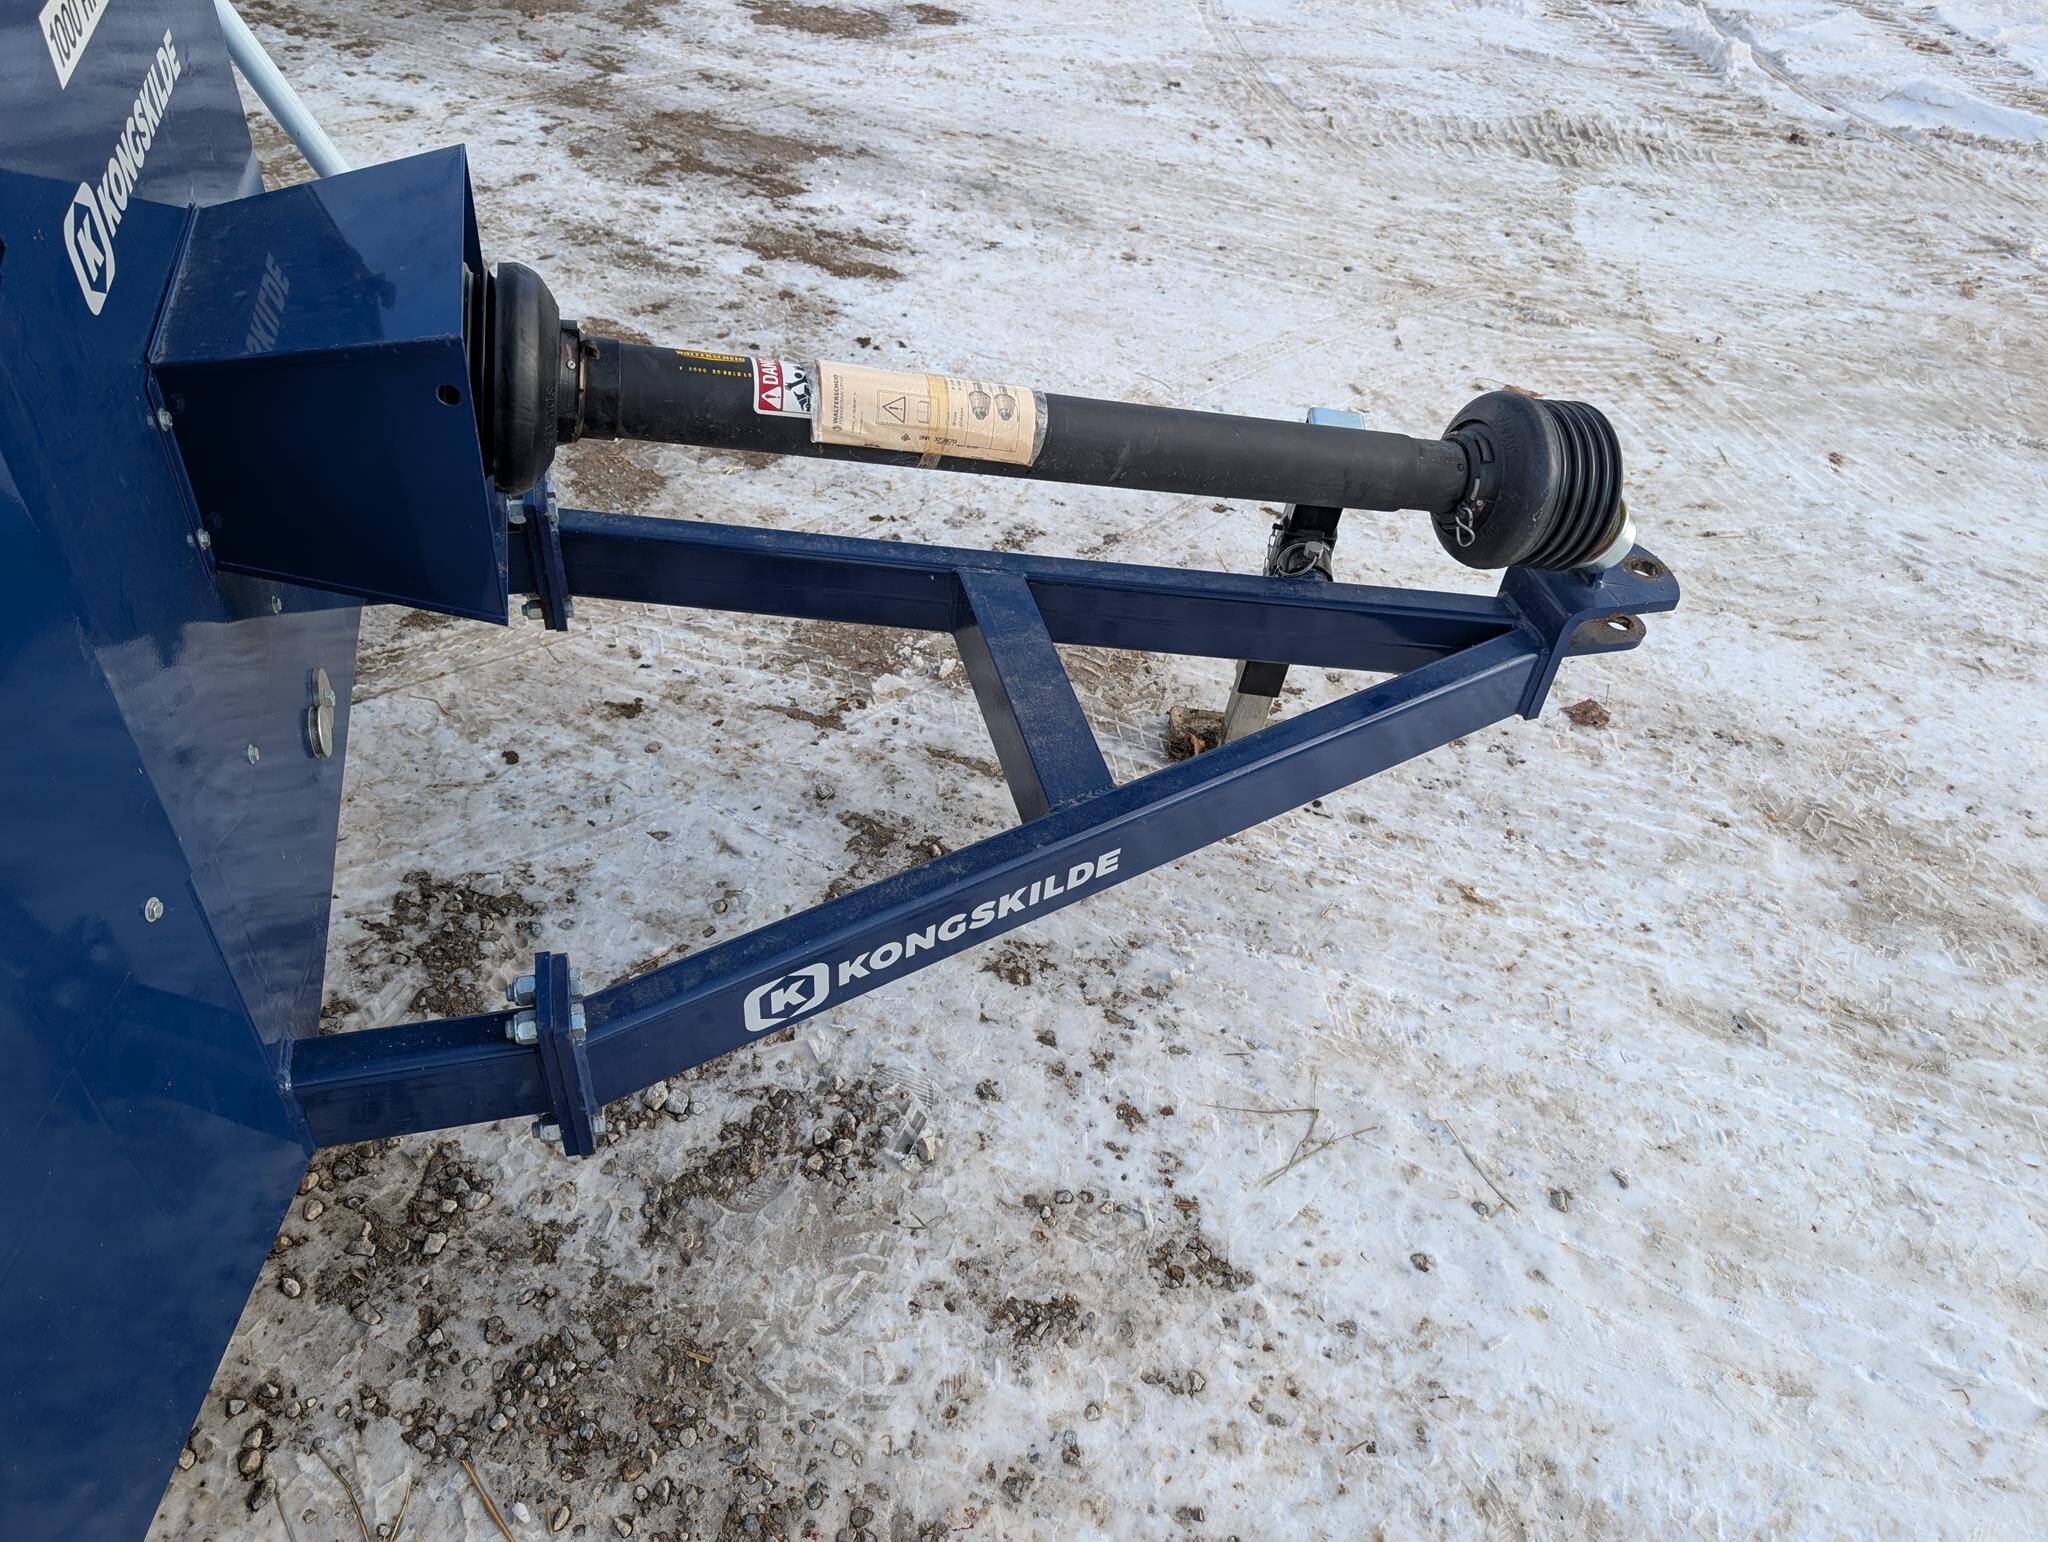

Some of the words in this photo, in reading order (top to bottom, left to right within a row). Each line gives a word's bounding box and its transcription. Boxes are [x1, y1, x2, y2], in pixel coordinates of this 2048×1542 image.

[49, 0, 82, 68] 1000
[97, 28, 182, 238] KONGSKILDE
[838, 848, 1122, 987] KONGSKILDE
